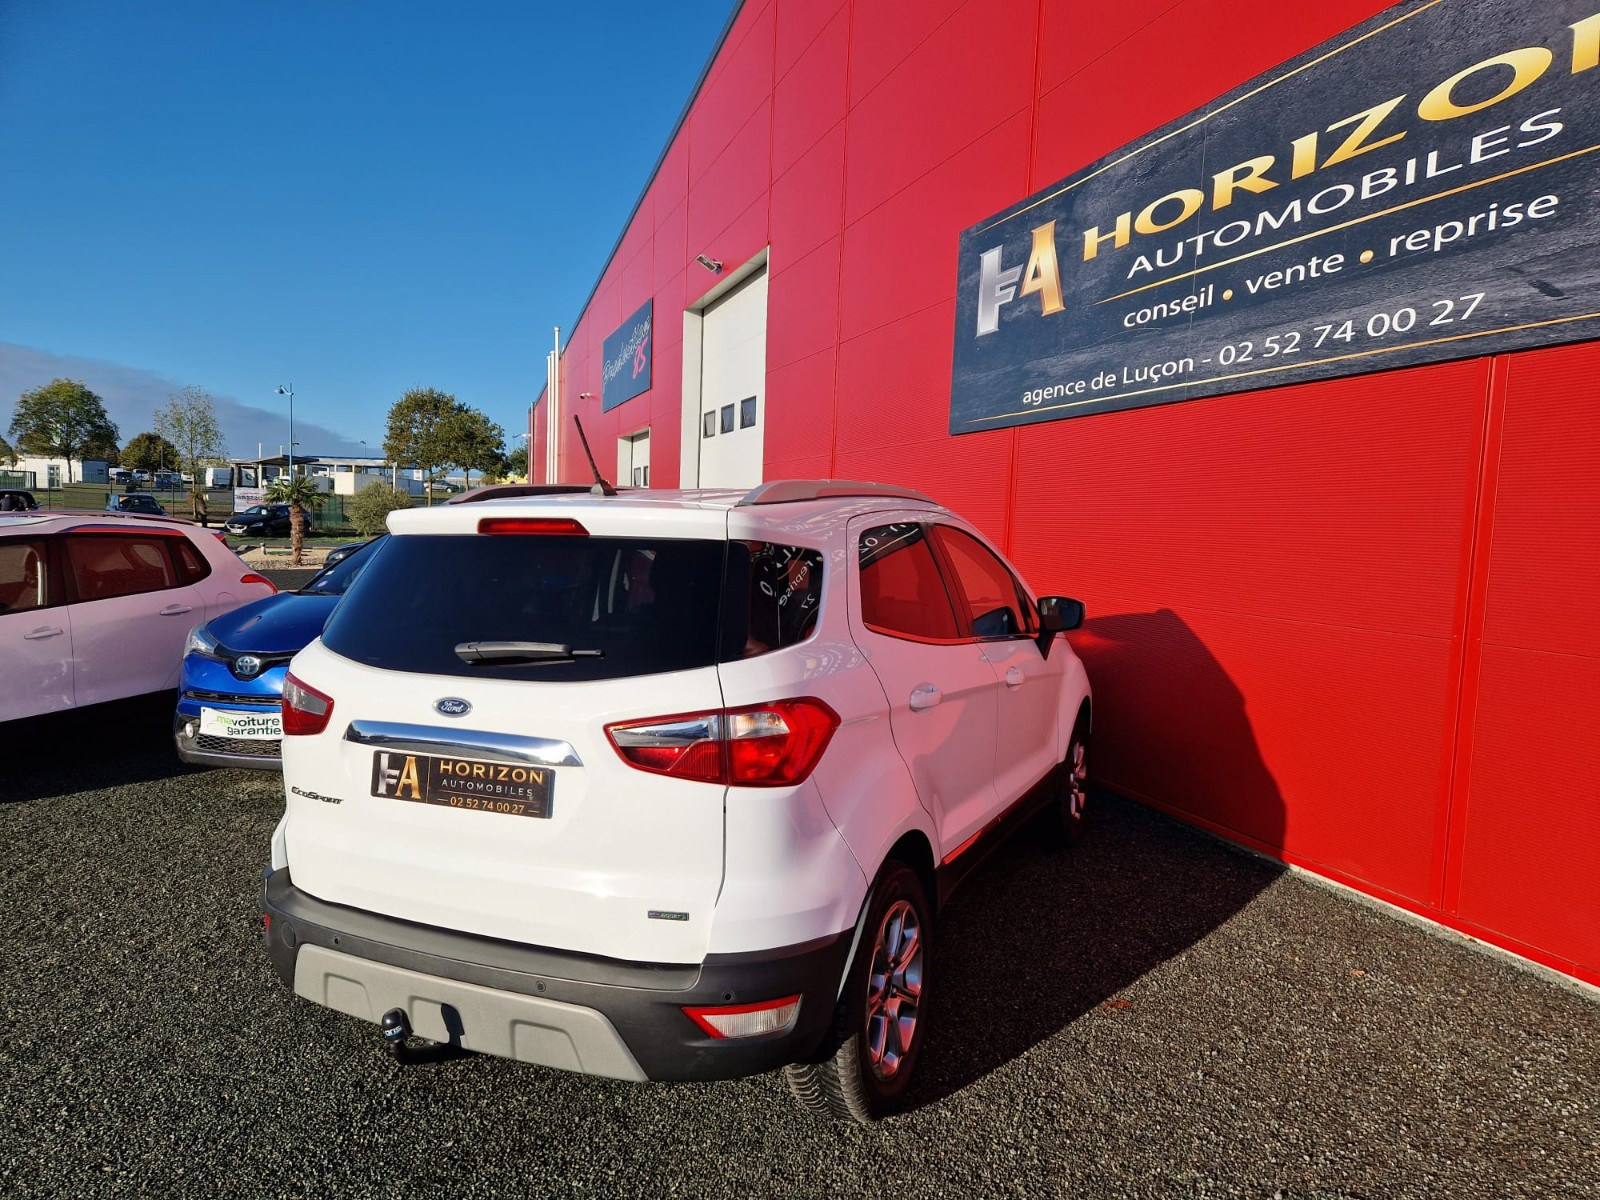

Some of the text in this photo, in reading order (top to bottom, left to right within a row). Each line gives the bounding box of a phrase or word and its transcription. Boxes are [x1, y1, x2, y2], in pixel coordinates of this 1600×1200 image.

[1127, 107, 1564, 279] AUTOMOBILES
[1123, 194, 1559, 328] conseil vente reprise
[1022, 380, 1086, 405] agence
[1091, 371, 1116, 390] de
[1122, 357, 1194, 384] Luçon
[1218, 341, 1253, 366] 02
[1262, 331, 1301, 358] 52
[1313, 320, 1355, 348] 74
[1366, 307, 1417, 337] 00
[1428, 292, 1485, 326] 27
[227, 726, 282, 736] garantie
[439, 760, 544, 786] HORIZON
[441, 778, 533, 797] AUTOMOBILES
[450, 796, 525, 815] 02 52 74 00 27
